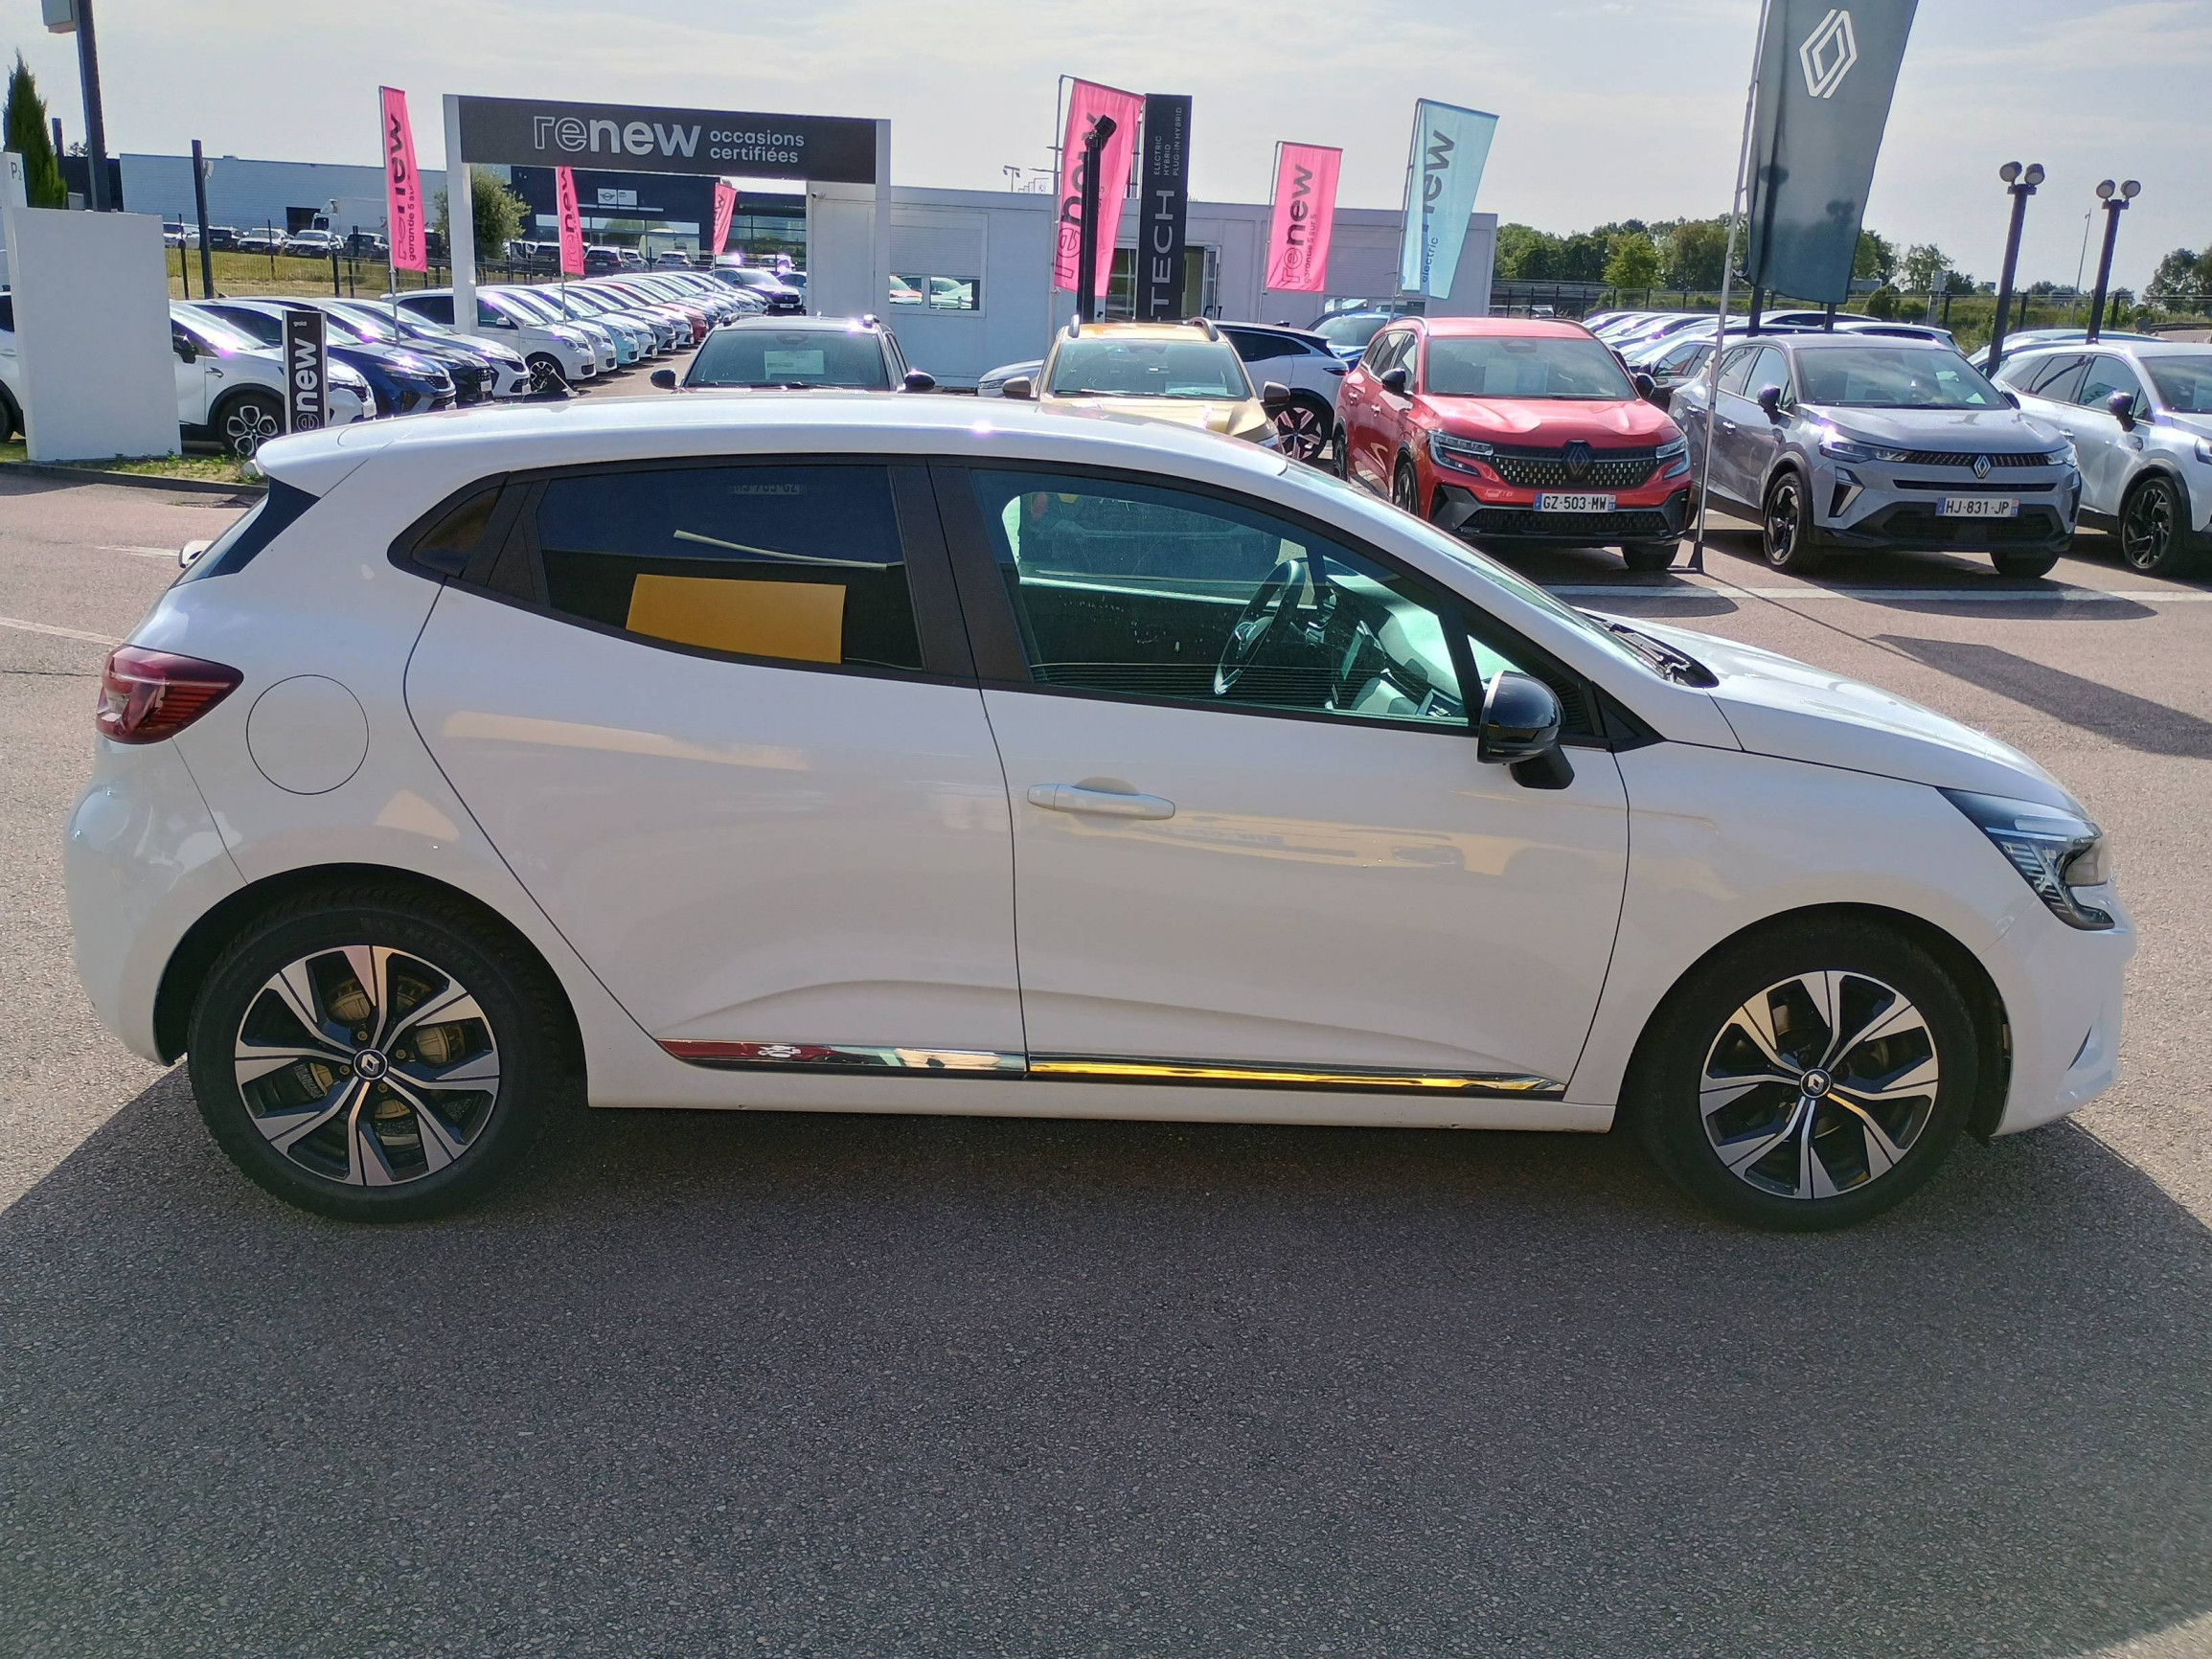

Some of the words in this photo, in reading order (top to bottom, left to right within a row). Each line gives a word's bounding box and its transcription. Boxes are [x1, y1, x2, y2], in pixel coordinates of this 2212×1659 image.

[534, 116, 701, 158] renew
[709, 129, 805, 147] occasions
[709, 146, 798, 164] certifiées
[1153, 135, 1162, 175] ELECTRIC
[1173, 141, 1181, 176] PLUG-IN
[1282, 164, 1313, 284] renew
[1423, 237, 1438, 284] electric
[295, 337, 320, 432] enew
[1946, 500, 2009, 514] HJ-831-JP
